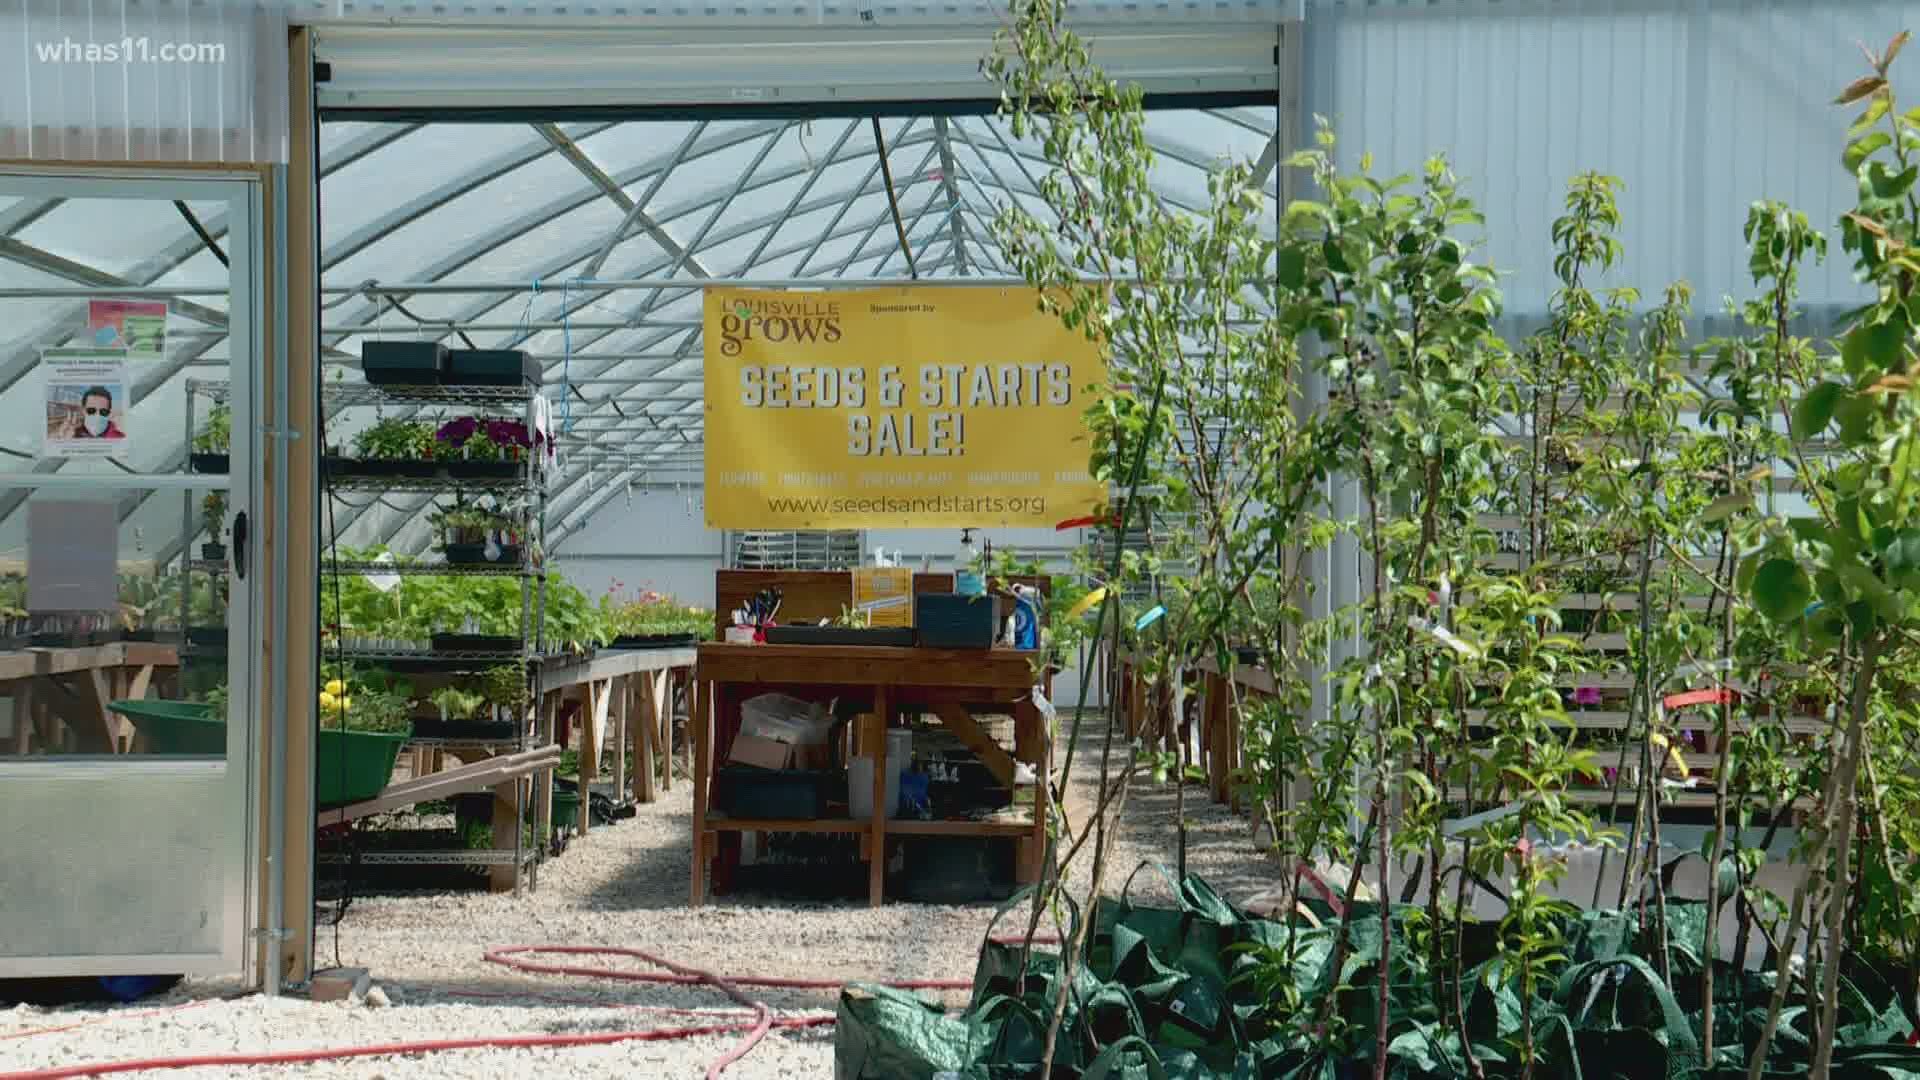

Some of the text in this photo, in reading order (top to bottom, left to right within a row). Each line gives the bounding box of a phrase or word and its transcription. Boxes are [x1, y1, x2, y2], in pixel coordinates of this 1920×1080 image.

[721, 298, 840, 316] LOUISVILLE
[922, 303, 936, 313] by
[720, 313, 842, 357] grows
[740, 361, 1072, 409] SEEDS & STARTS
[847, 412, 967, 457] SALE!
[768, 495, 1046, 515] www.seedsandstarts.org
